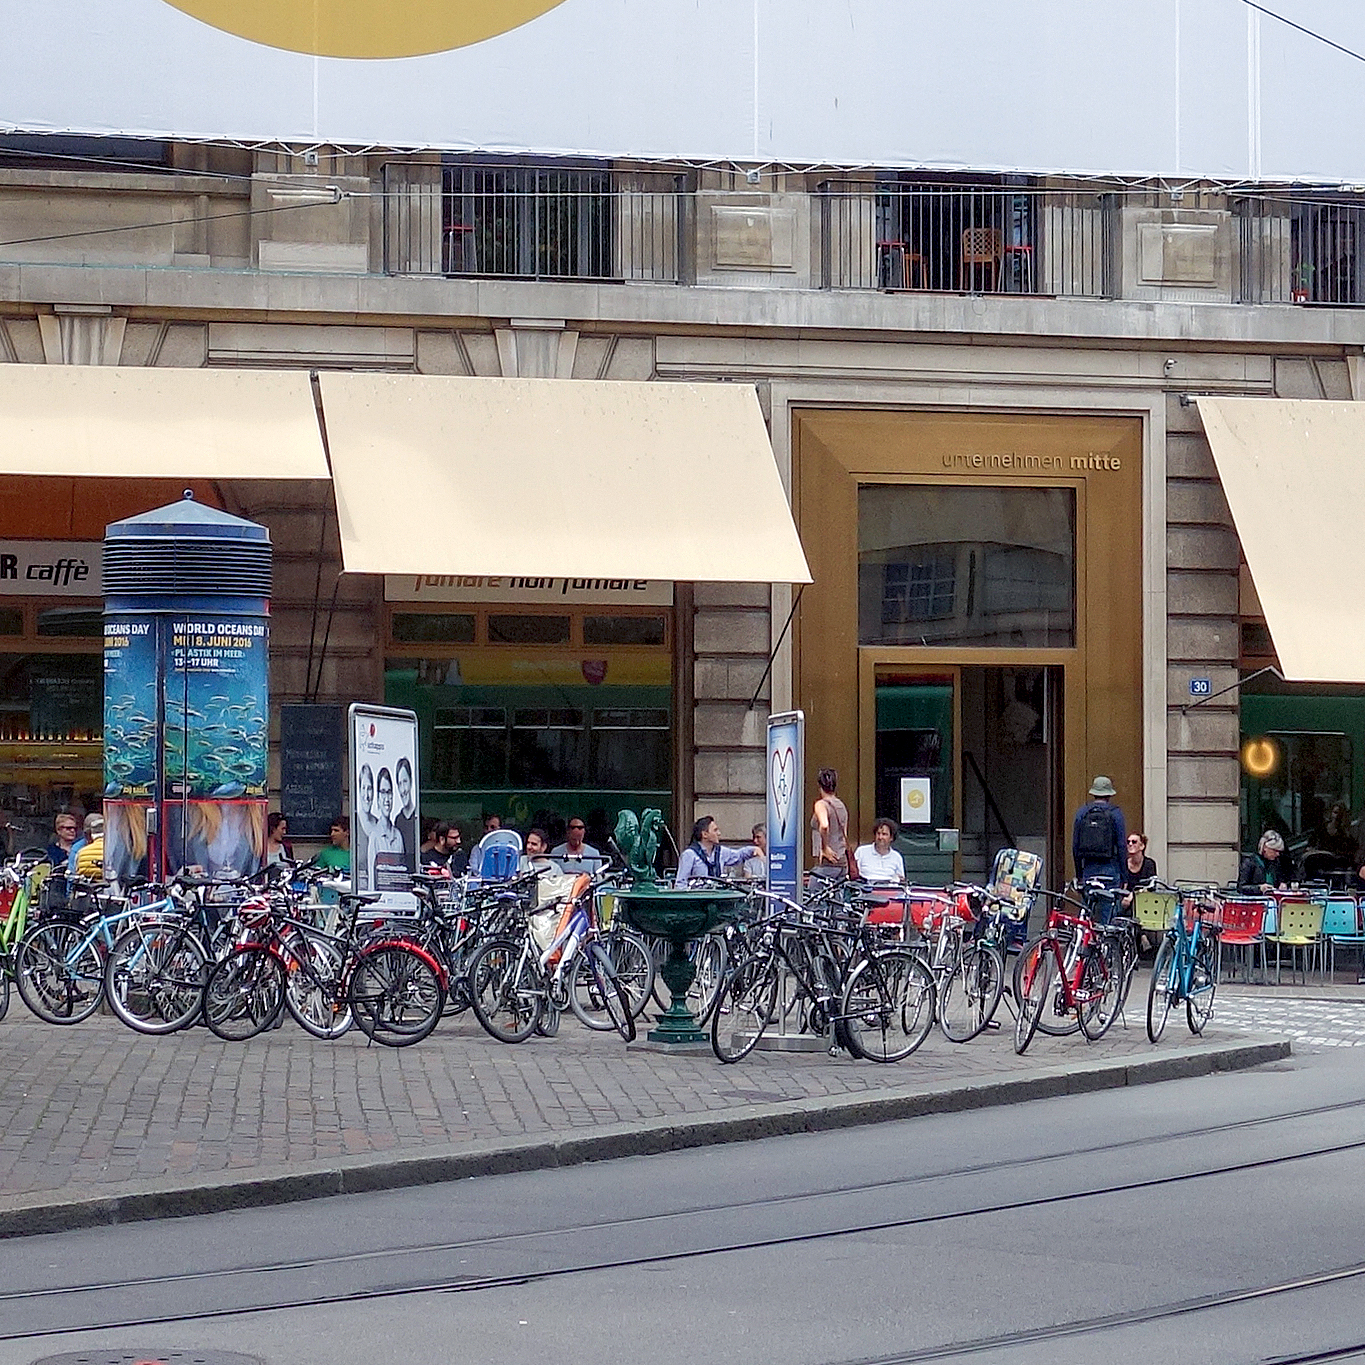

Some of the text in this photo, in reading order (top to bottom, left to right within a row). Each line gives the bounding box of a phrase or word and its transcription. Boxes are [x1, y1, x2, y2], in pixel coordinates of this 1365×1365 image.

[942, 451, 1122, 470] unternehmen mitte
[25, 558, 90, 587] caffè
[132, 623, 150, 635] DAY
[172, 622, 216, 635] WORLD
[217, 623, 252, 636] OCEANS
[207, 636, 232, 647] JUNI
[232, 637, 252, 648] 2016
[213, 649, 223, 658] IM
[200, 658, 219, 668] UHR
[1192, 679, 1208, 695] 30
